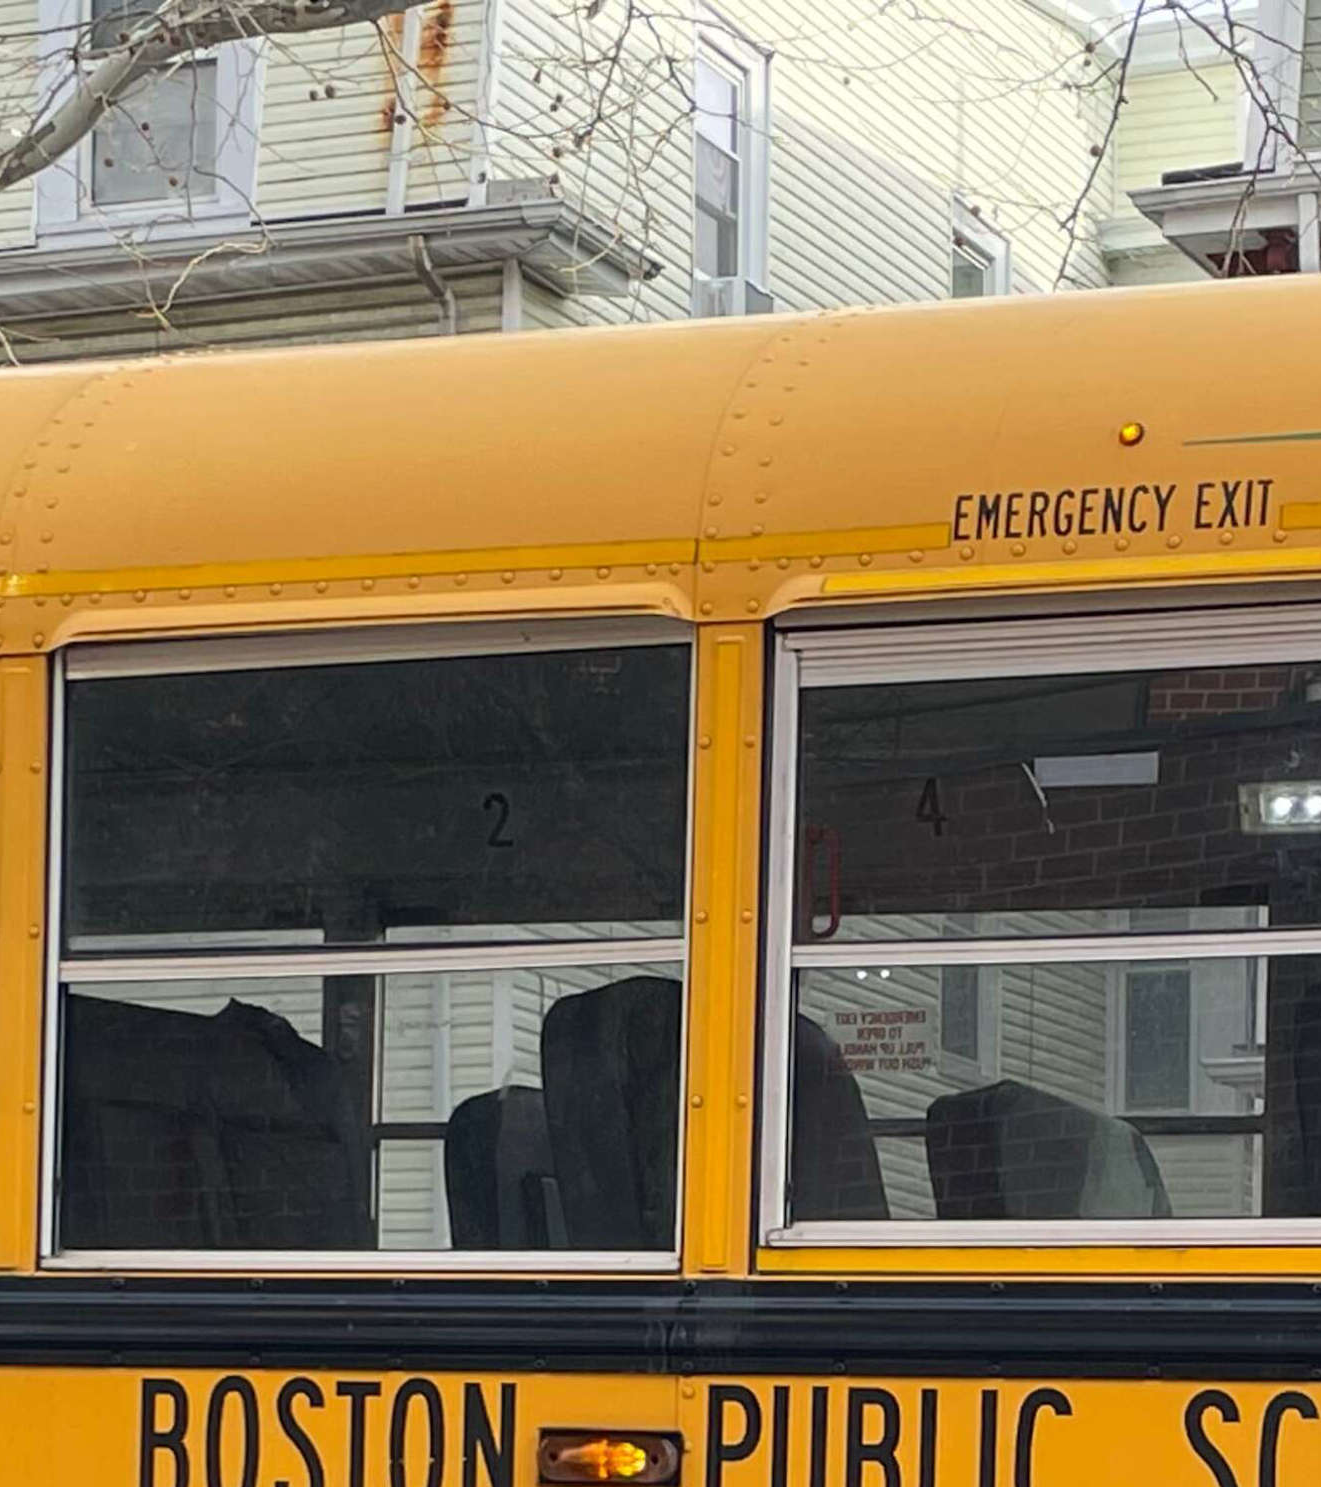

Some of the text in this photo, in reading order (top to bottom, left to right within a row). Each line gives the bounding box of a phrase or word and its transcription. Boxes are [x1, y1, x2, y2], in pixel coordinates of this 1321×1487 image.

[953, 479, 1274, 541] EMERGENCY EXIT
[483, 793, 514, 847] 2
[916, 777, 949, 836] 4
